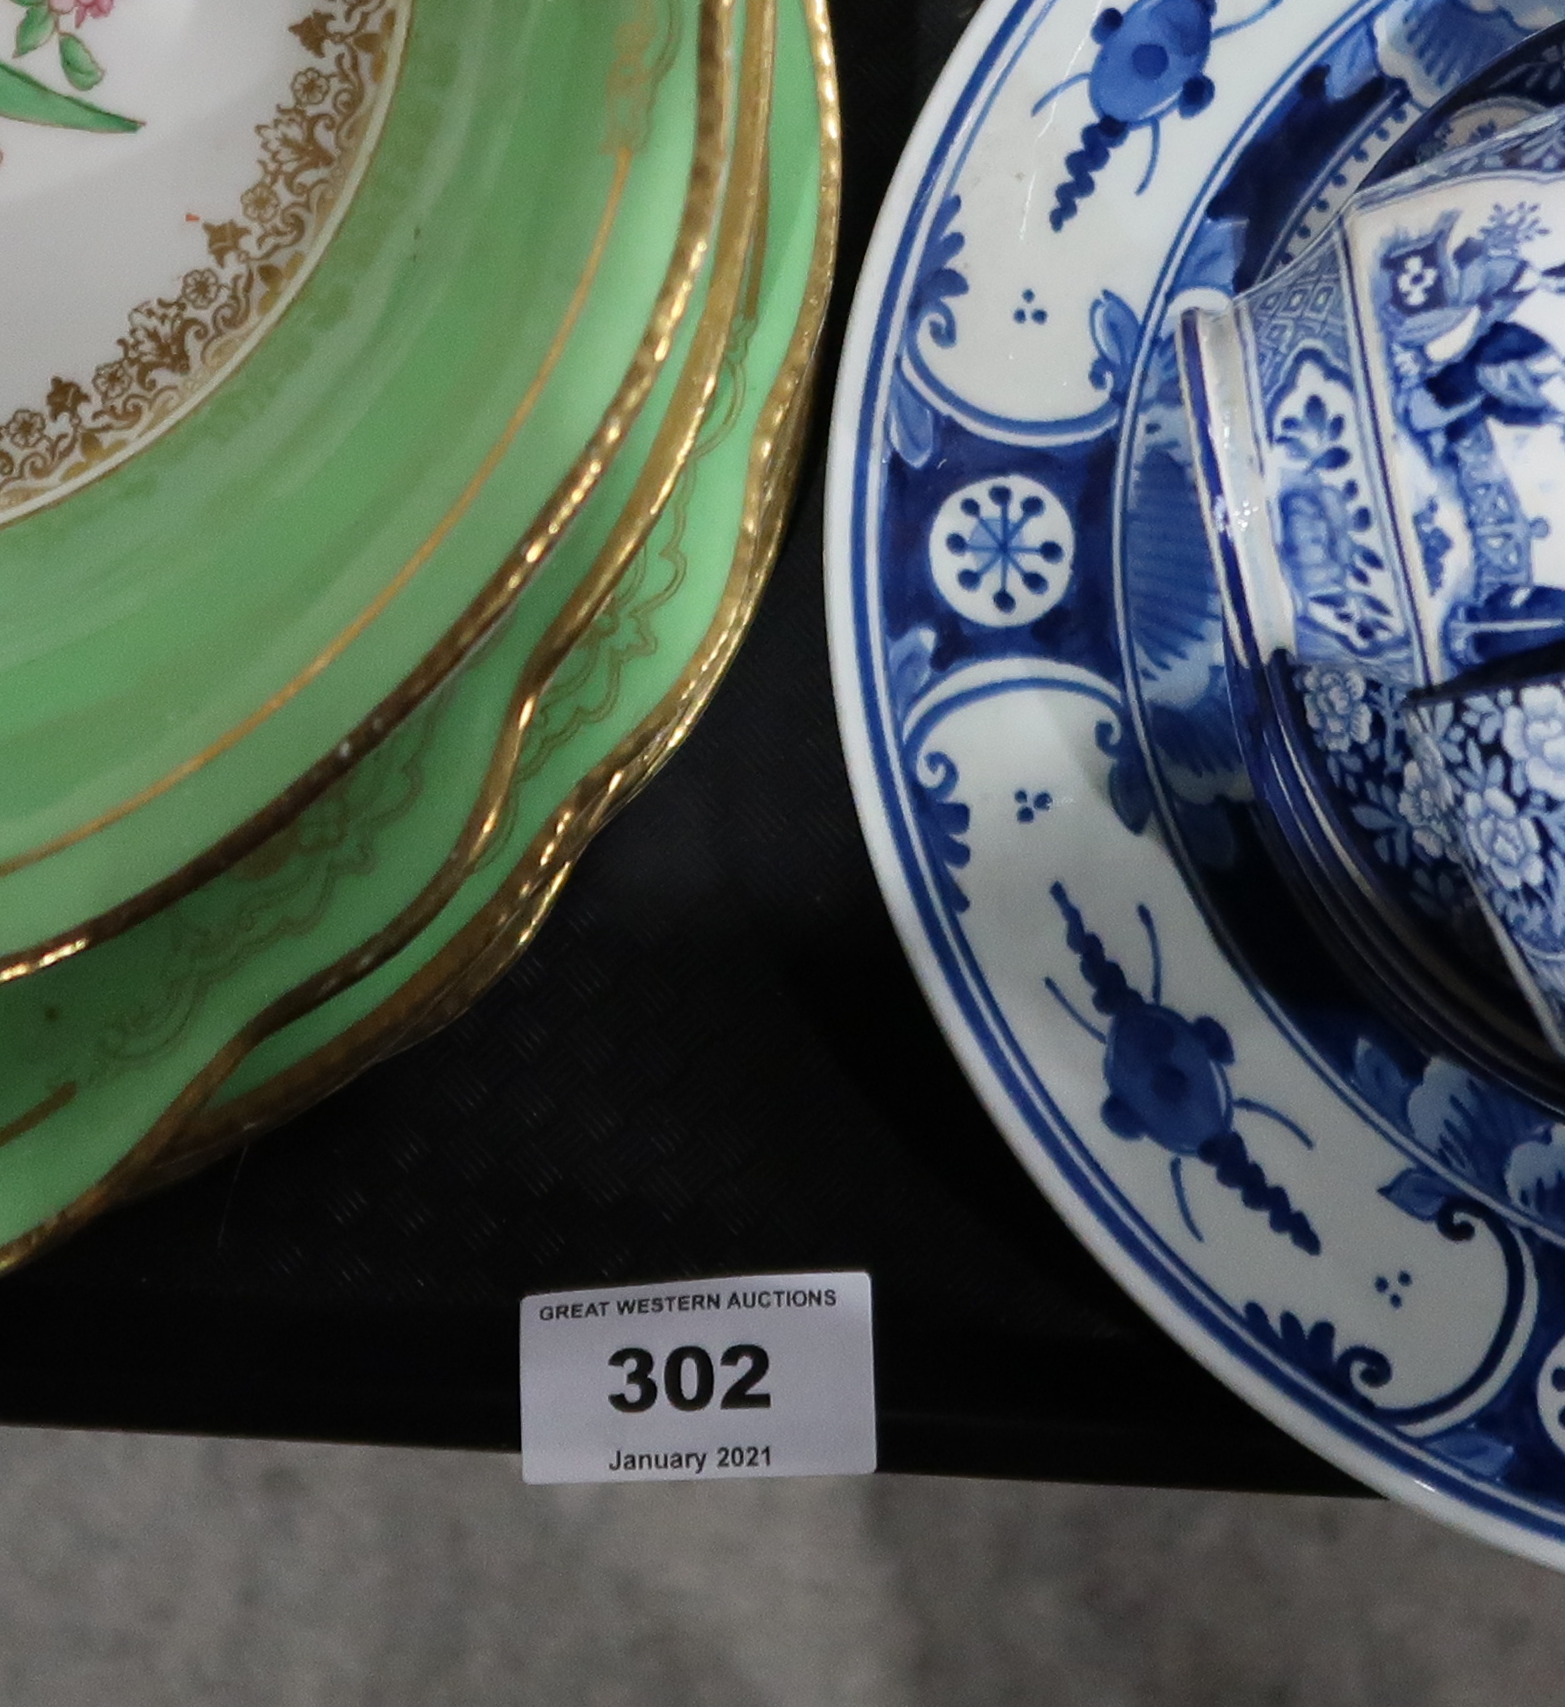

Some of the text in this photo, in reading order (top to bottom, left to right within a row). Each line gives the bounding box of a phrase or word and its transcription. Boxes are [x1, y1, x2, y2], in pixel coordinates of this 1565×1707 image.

[539, 1289, 837, 1321] GREAT WESTERN AUCTIONS
[607, 1343, 772, 1414] 302
[609, 1446, 772, 1473] January 2021
